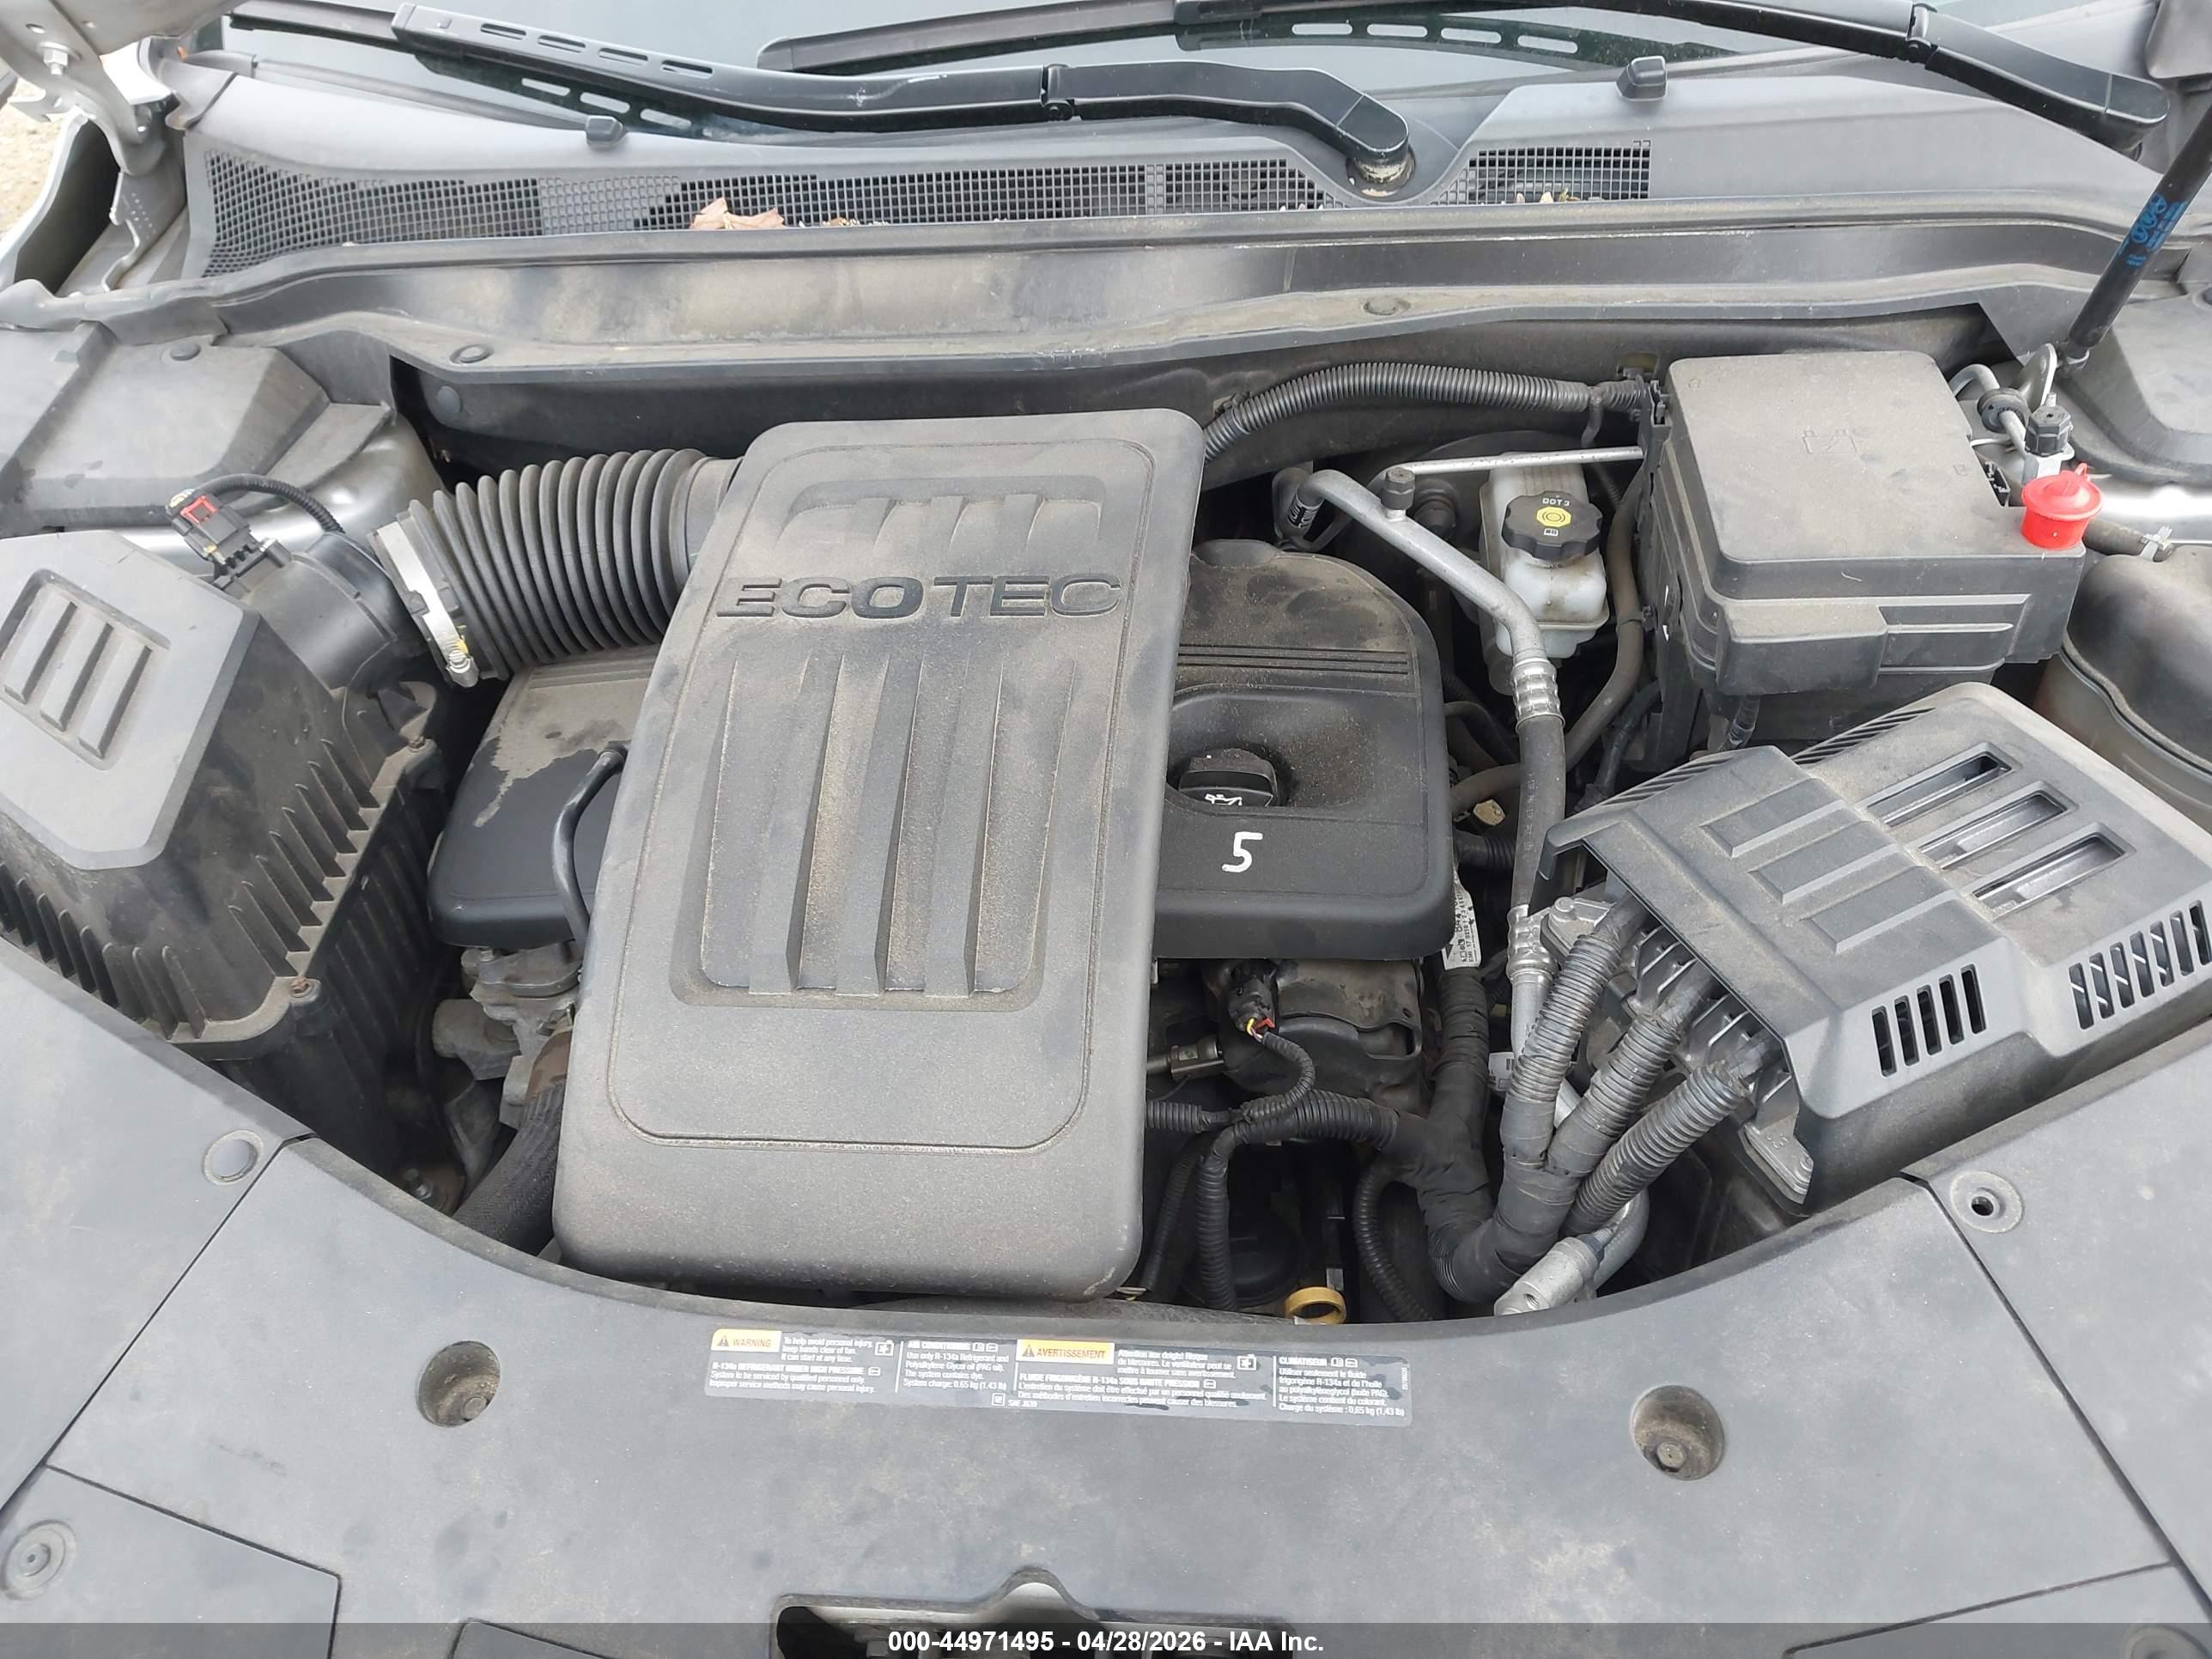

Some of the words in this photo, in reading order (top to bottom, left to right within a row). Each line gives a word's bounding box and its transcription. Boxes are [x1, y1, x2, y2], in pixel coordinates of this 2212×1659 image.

[715, 573, 1121, 619] ECOTEC
[1221, 830, 1263, 873] 5
[732, 1339, 771, 1347] WARNING
[920, 1352, 934, 1361] only
[959, 1353, 996, 1363] Refrigerant
[1036, 1348, 1105, 1358] AVERTISSEMENT
[709, 1370, 735, 1380] System
[752, 1372, 780, 1381] serviced
[905, 1369, 917, 1377] The
[917, 1370, 942, 1379] system
[942, 1371, 970, 1380] contains
[902, 1378, 927, 1387] System
[928, 1380, 952, 1389] charge:
[953, 1380, 969, 1389] 0.65
[969, 1381, 979, 1390] kg
[979, 1381, 998, 1390] (1.43
[1091, 1376, 1118, 1385] R-134a
[1316, 1377, 1342, 1387] R-134a
[1279, 1403, 1304, 1413] Charge
[1304, 1404, 1315, 1413] du
[1365, 1407, 1375, 1417] kg
